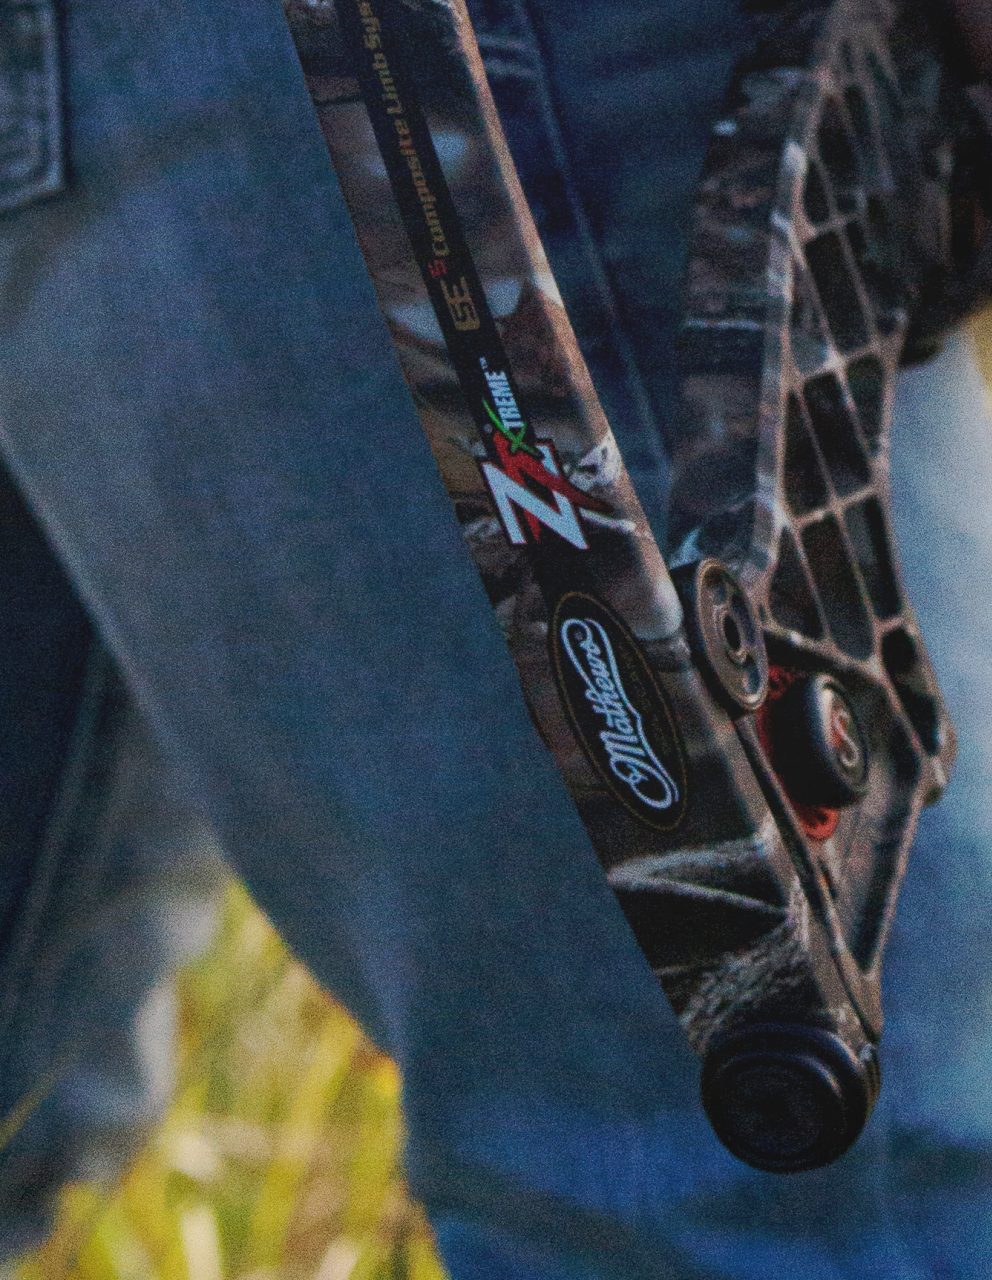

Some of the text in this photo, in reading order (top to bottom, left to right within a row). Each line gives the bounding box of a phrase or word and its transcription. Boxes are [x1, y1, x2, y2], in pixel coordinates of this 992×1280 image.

[373, 52, 405, 115] Limb
[394, 119, 450, 256] Composite
[561, 618, 679, 810] Mathews
